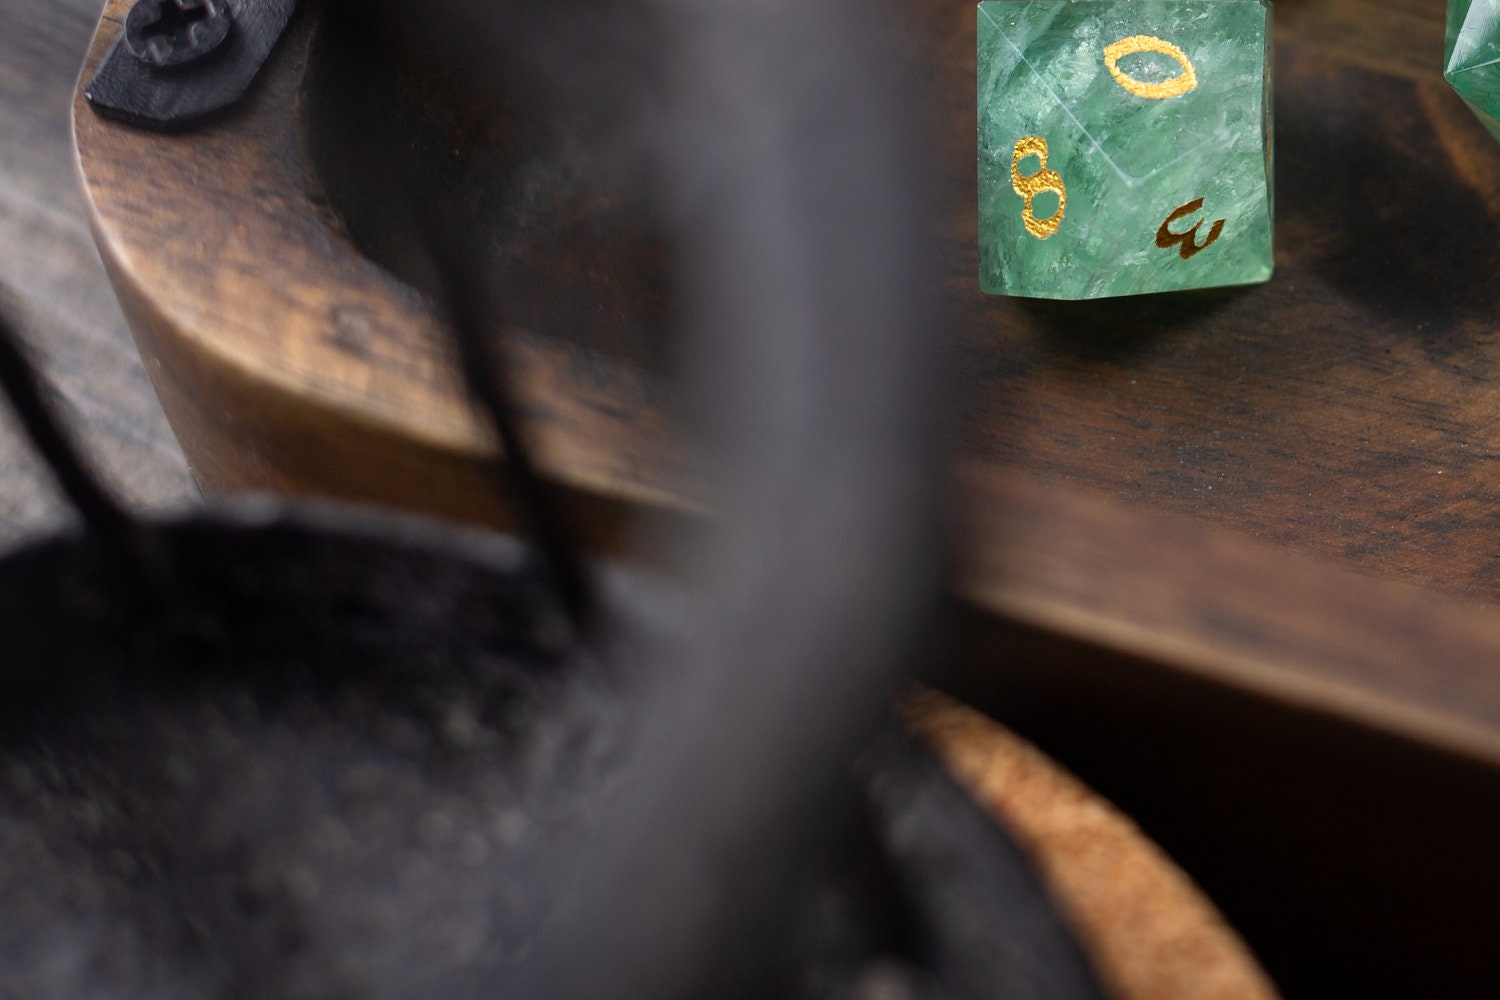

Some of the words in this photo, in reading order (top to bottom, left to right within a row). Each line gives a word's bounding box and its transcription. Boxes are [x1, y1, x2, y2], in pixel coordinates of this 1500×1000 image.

[1103, 35, 1198, 99] 0
[1011, 135, 1067, 239] 8
[1155, 197, 1226, 259] 3
